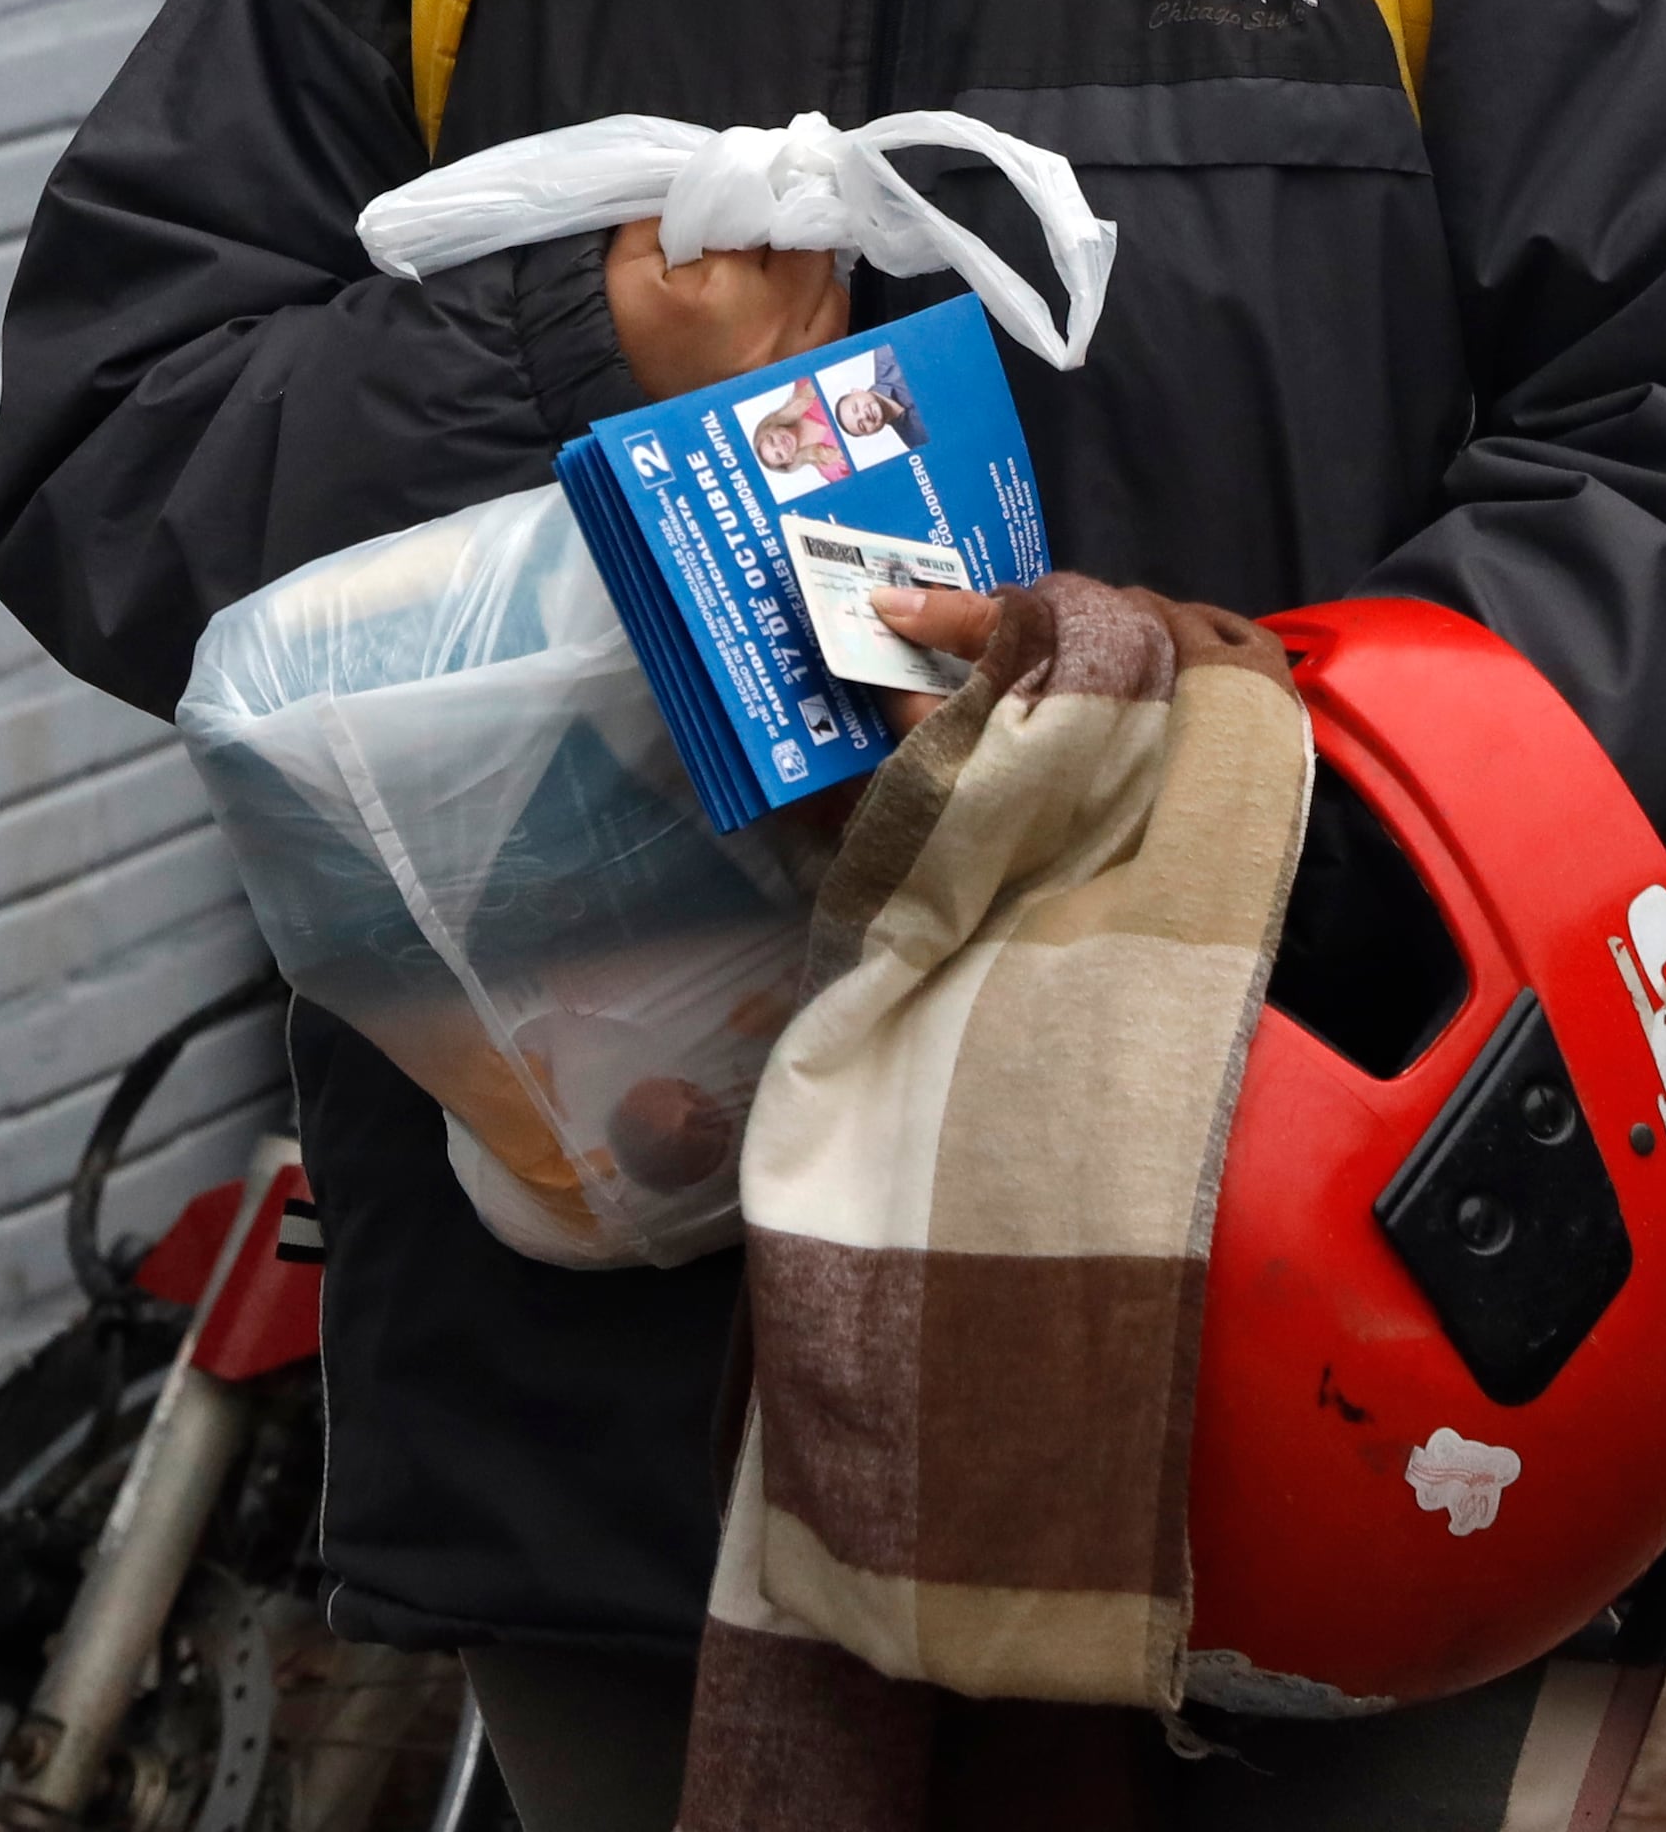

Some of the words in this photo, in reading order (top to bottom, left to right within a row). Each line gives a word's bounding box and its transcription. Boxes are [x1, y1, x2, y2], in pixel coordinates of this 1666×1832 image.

[628, 437, 671, 481] 2
[698, 408, 739, 470] CAPITAL
[727, 467, 772, 537] FORMOSA
[907, 452, 954, 546] COLODRERO
[986, 459, 1013, 521] Gabriela
[1003, 455, 1025, 508] Andrea
[1003, 482, 1022, 528] Javier
[654, 486, 691, 550] FORMOSA
[657, 516, 678, 547] 2025
[685, 448, 768, 591] OCTUBRE
[760, 535, 782, 558] DE
[971, 523, 990, 562] Angel
[674, 494, 749, 638] JUSTICIALISTA
[684, 549, 718, 608] DISTRITO
[960, 534, 982, 580] Leonor
[1005, 521, 1023, 580] Lourdes
[672, 547, 721, 639] PROVINCIALES
[756, 594, 790, 637] DE
[714, 615, 735, 645] 2025
[746, 596, 794, 686] SUBLEMA
[714, 639, 758, 719] ELECCIONES
[737, 664, 763, 704] JUNIO
[742, 639, 790, 727] PARTIDO
[780, 641, 811, 683] 17
